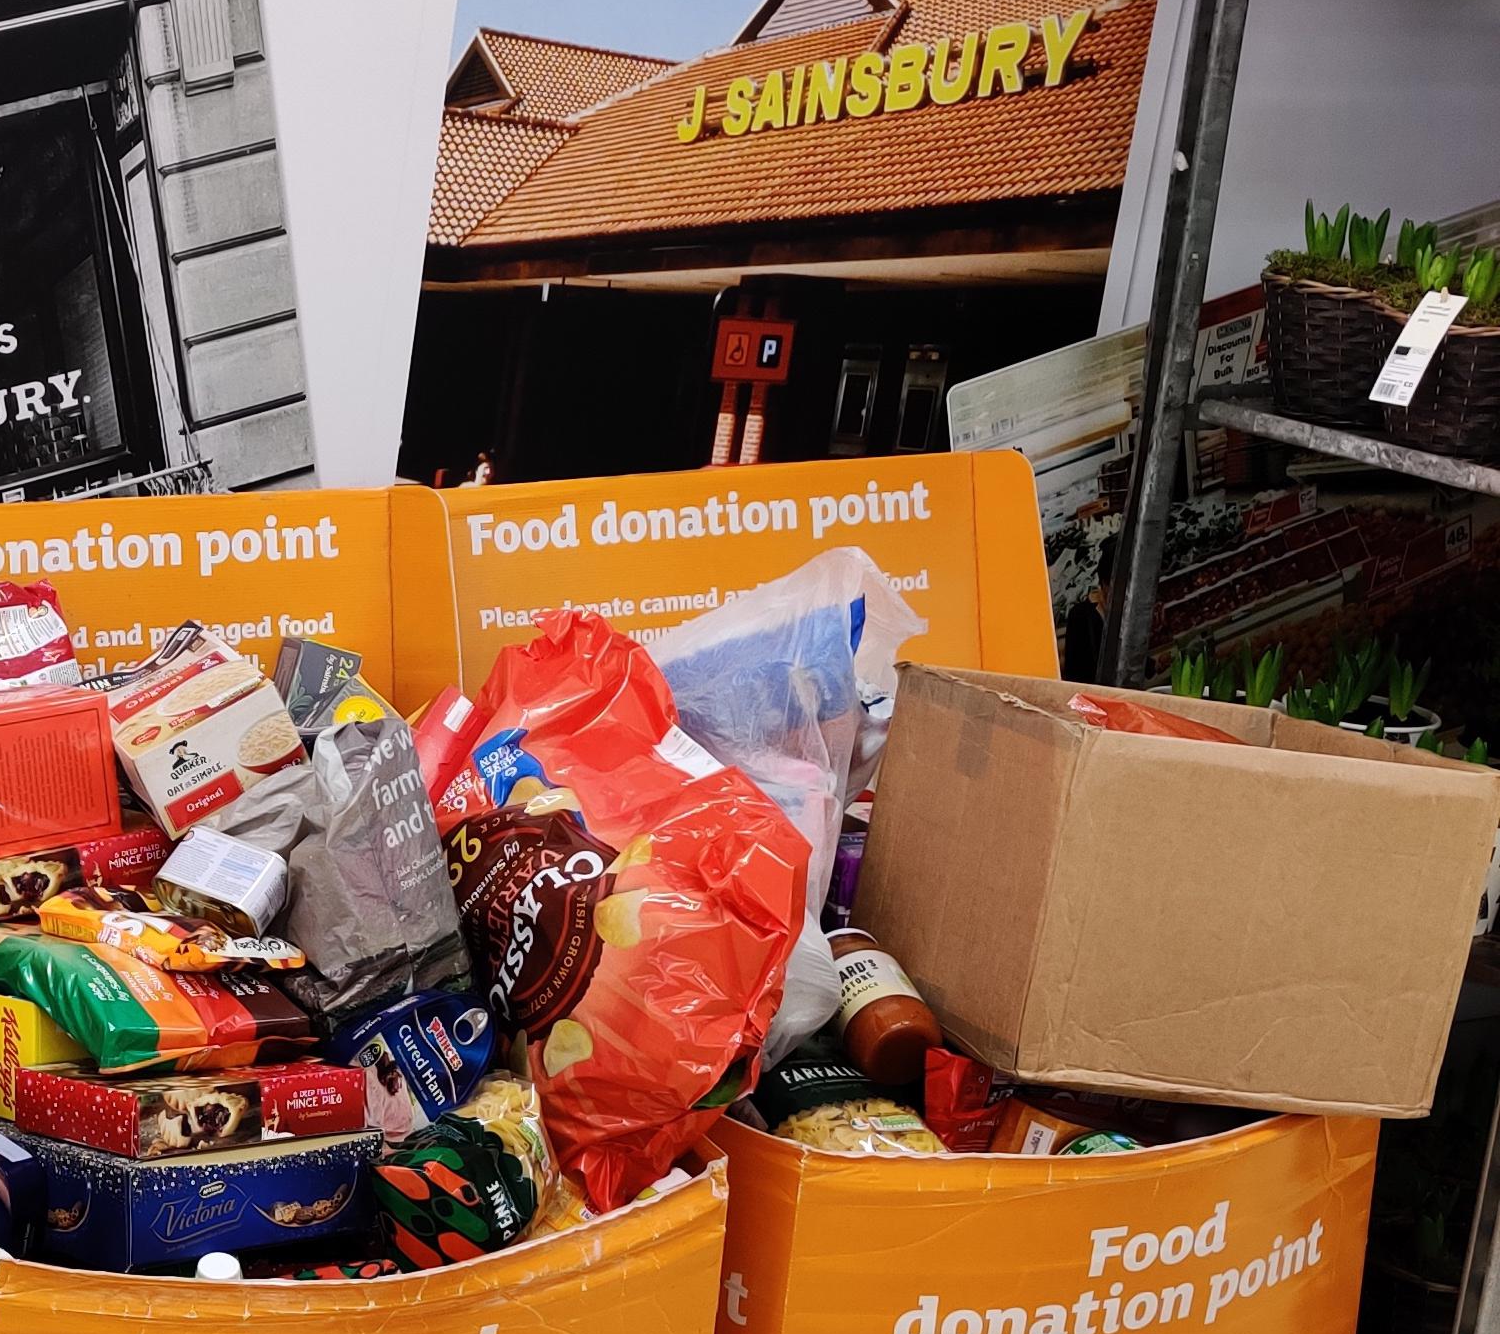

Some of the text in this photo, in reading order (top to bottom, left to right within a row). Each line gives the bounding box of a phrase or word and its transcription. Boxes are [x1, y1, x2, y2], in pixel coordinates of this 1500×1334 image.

[721, 7, 1094, 137] SAINSBURY
[194, 512, 340, 577] point
[466, 479, 931, 557] Food donation point
[639, 587, 720, 616] canned
[94, 622, 144, 648] and
[148, 615, 273, 648] paaged
[277, 612, 335, 638] food
[170, 756, 207, 780] QUAKER
[185, 786, 225, 813] Original
[383, 800, 424, 849] and
[108, 854, 144, 870] MINCE
[398, 1024, 425, 1071] Cured
[421, 1066, 447, 1107] Ham
[426, 1015, 463, 1072] PRINCES
[286, 1095, 319, 1111] MINCE
[165, 1197, 236, 1238] Victoria
[485, 1179, 517, 1242] PENNE
[1088, 1200, 1231, 1278] Food
[1203, 1218, 1325, 1325] point
